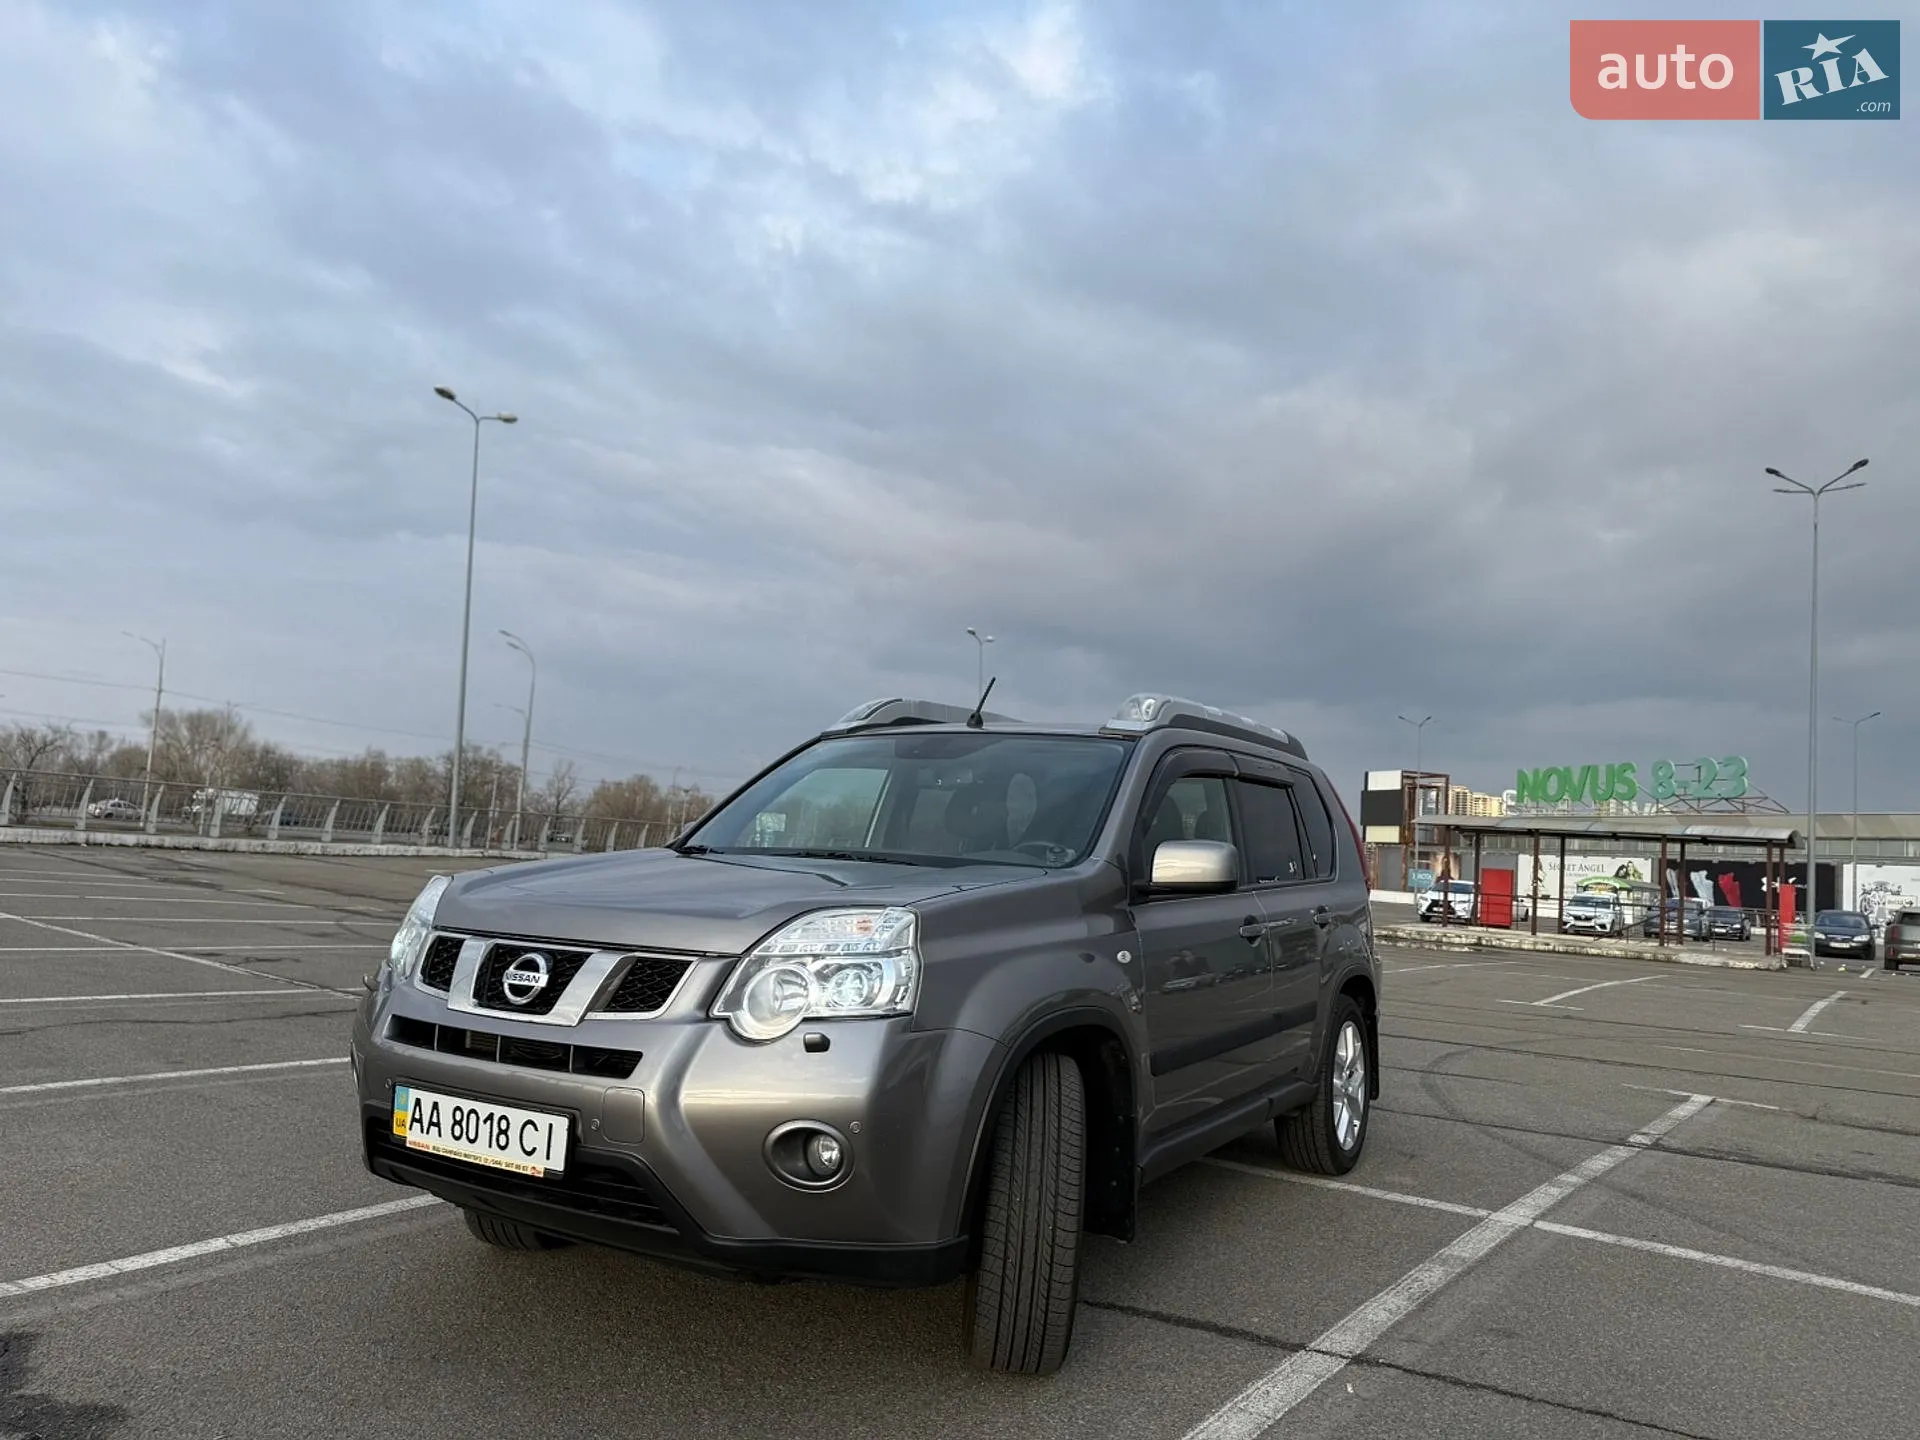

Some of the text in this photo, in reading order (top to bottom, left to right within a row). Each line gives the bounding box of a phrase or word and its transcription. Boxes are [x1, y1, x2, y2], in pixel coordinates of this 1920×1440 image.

[1517, 761, 1638, 803] NOVUS
[1651, 756, 1748, 801] 8-23
[505, 972, 540, 984] NISSAN
[395, 1116, 406, 1129] UA
[409, 1098, 442, 1138] AA
[451, 1106, 511, 1151] 8018
